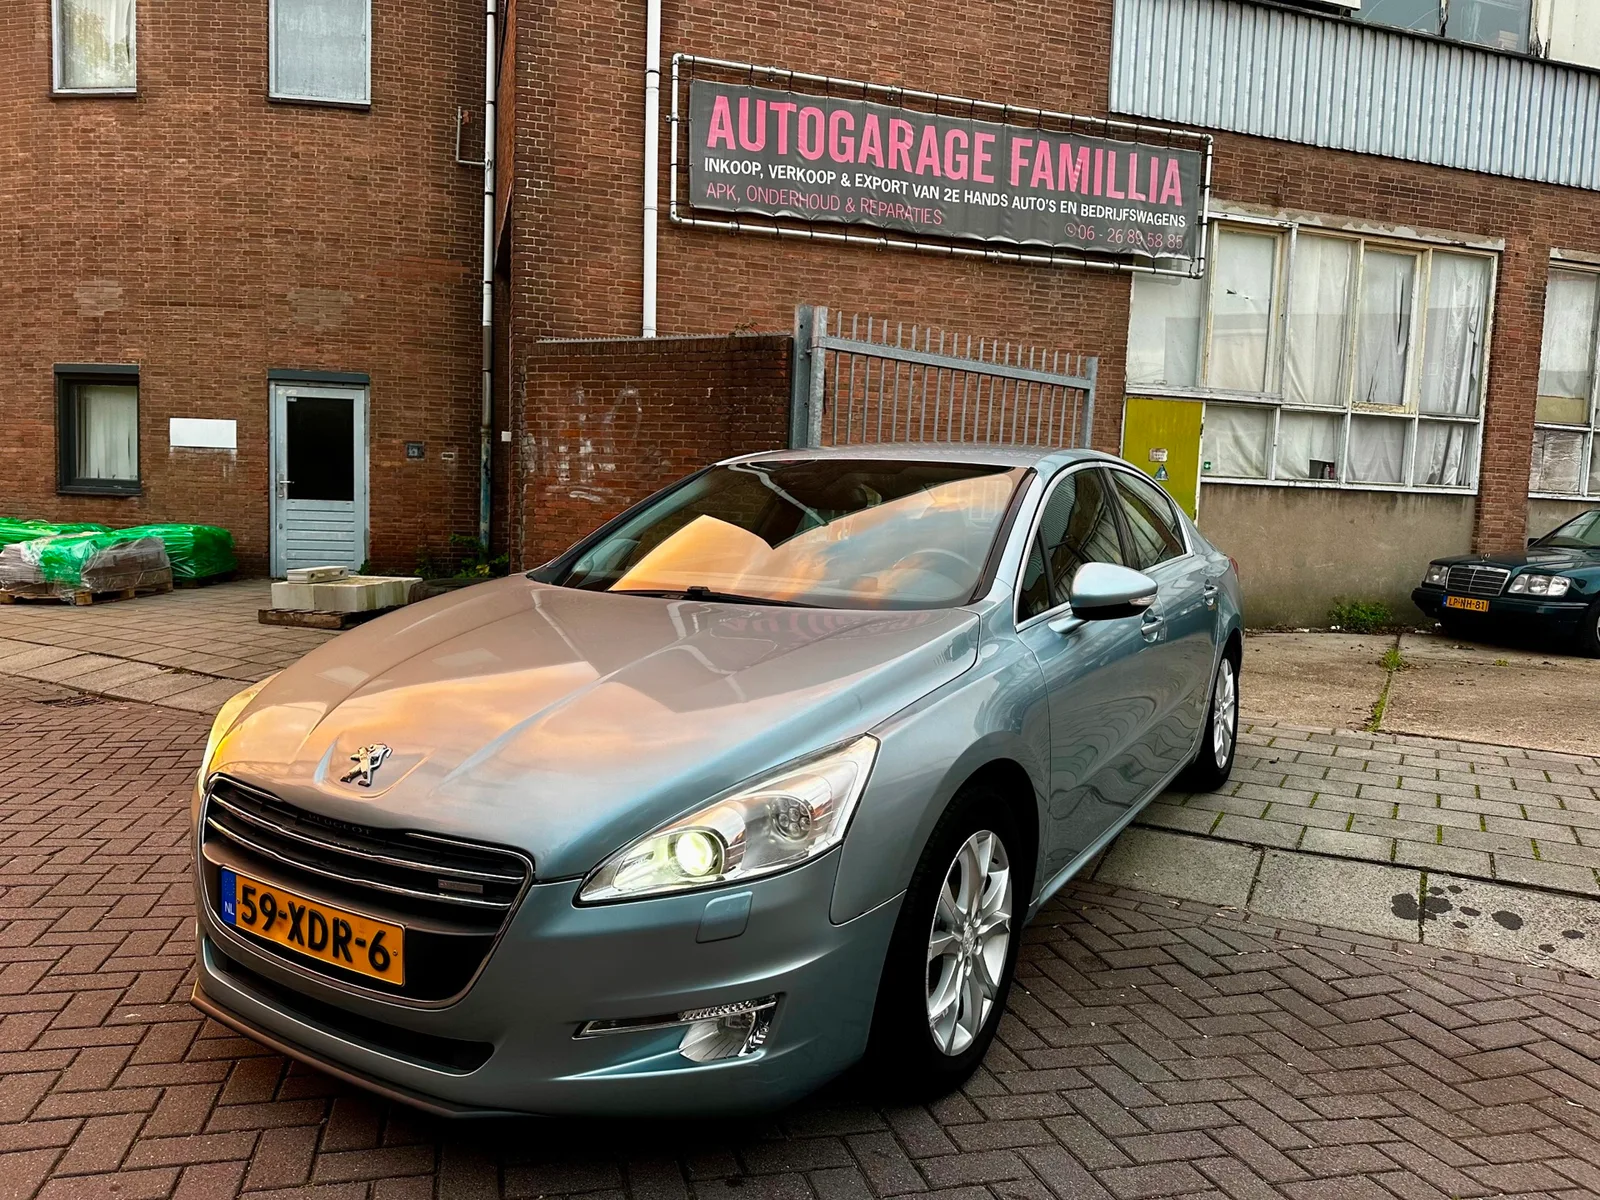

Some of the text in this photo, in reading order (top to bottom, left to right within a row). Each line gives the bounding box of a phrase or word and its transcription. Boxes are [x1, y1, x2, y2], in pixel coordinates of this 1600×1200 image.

[707, 95, 1183, 206] AUTOGARAGE FAMILLIA
[704, 157, 1186, 227] INKOOP, VERKOOP & EXPORT VAN 2E HANDS AUTO'S EN BEDRIJFSWAGENS
[706, 182, 942, 225] APK, ONDERHOUD & REPARATIES
[1079, 224, 1095, 241] 06
[1107, 228, 1123, 244] 26
[1147, 232, 1163, 248] 58
[1167, 234, 1183, 249] 85
[1448, 597, 1485, 611] LP-NH-81
[224, 901, 235, 915] NL
[241, 884, 391, 972] 59-XDR-6
